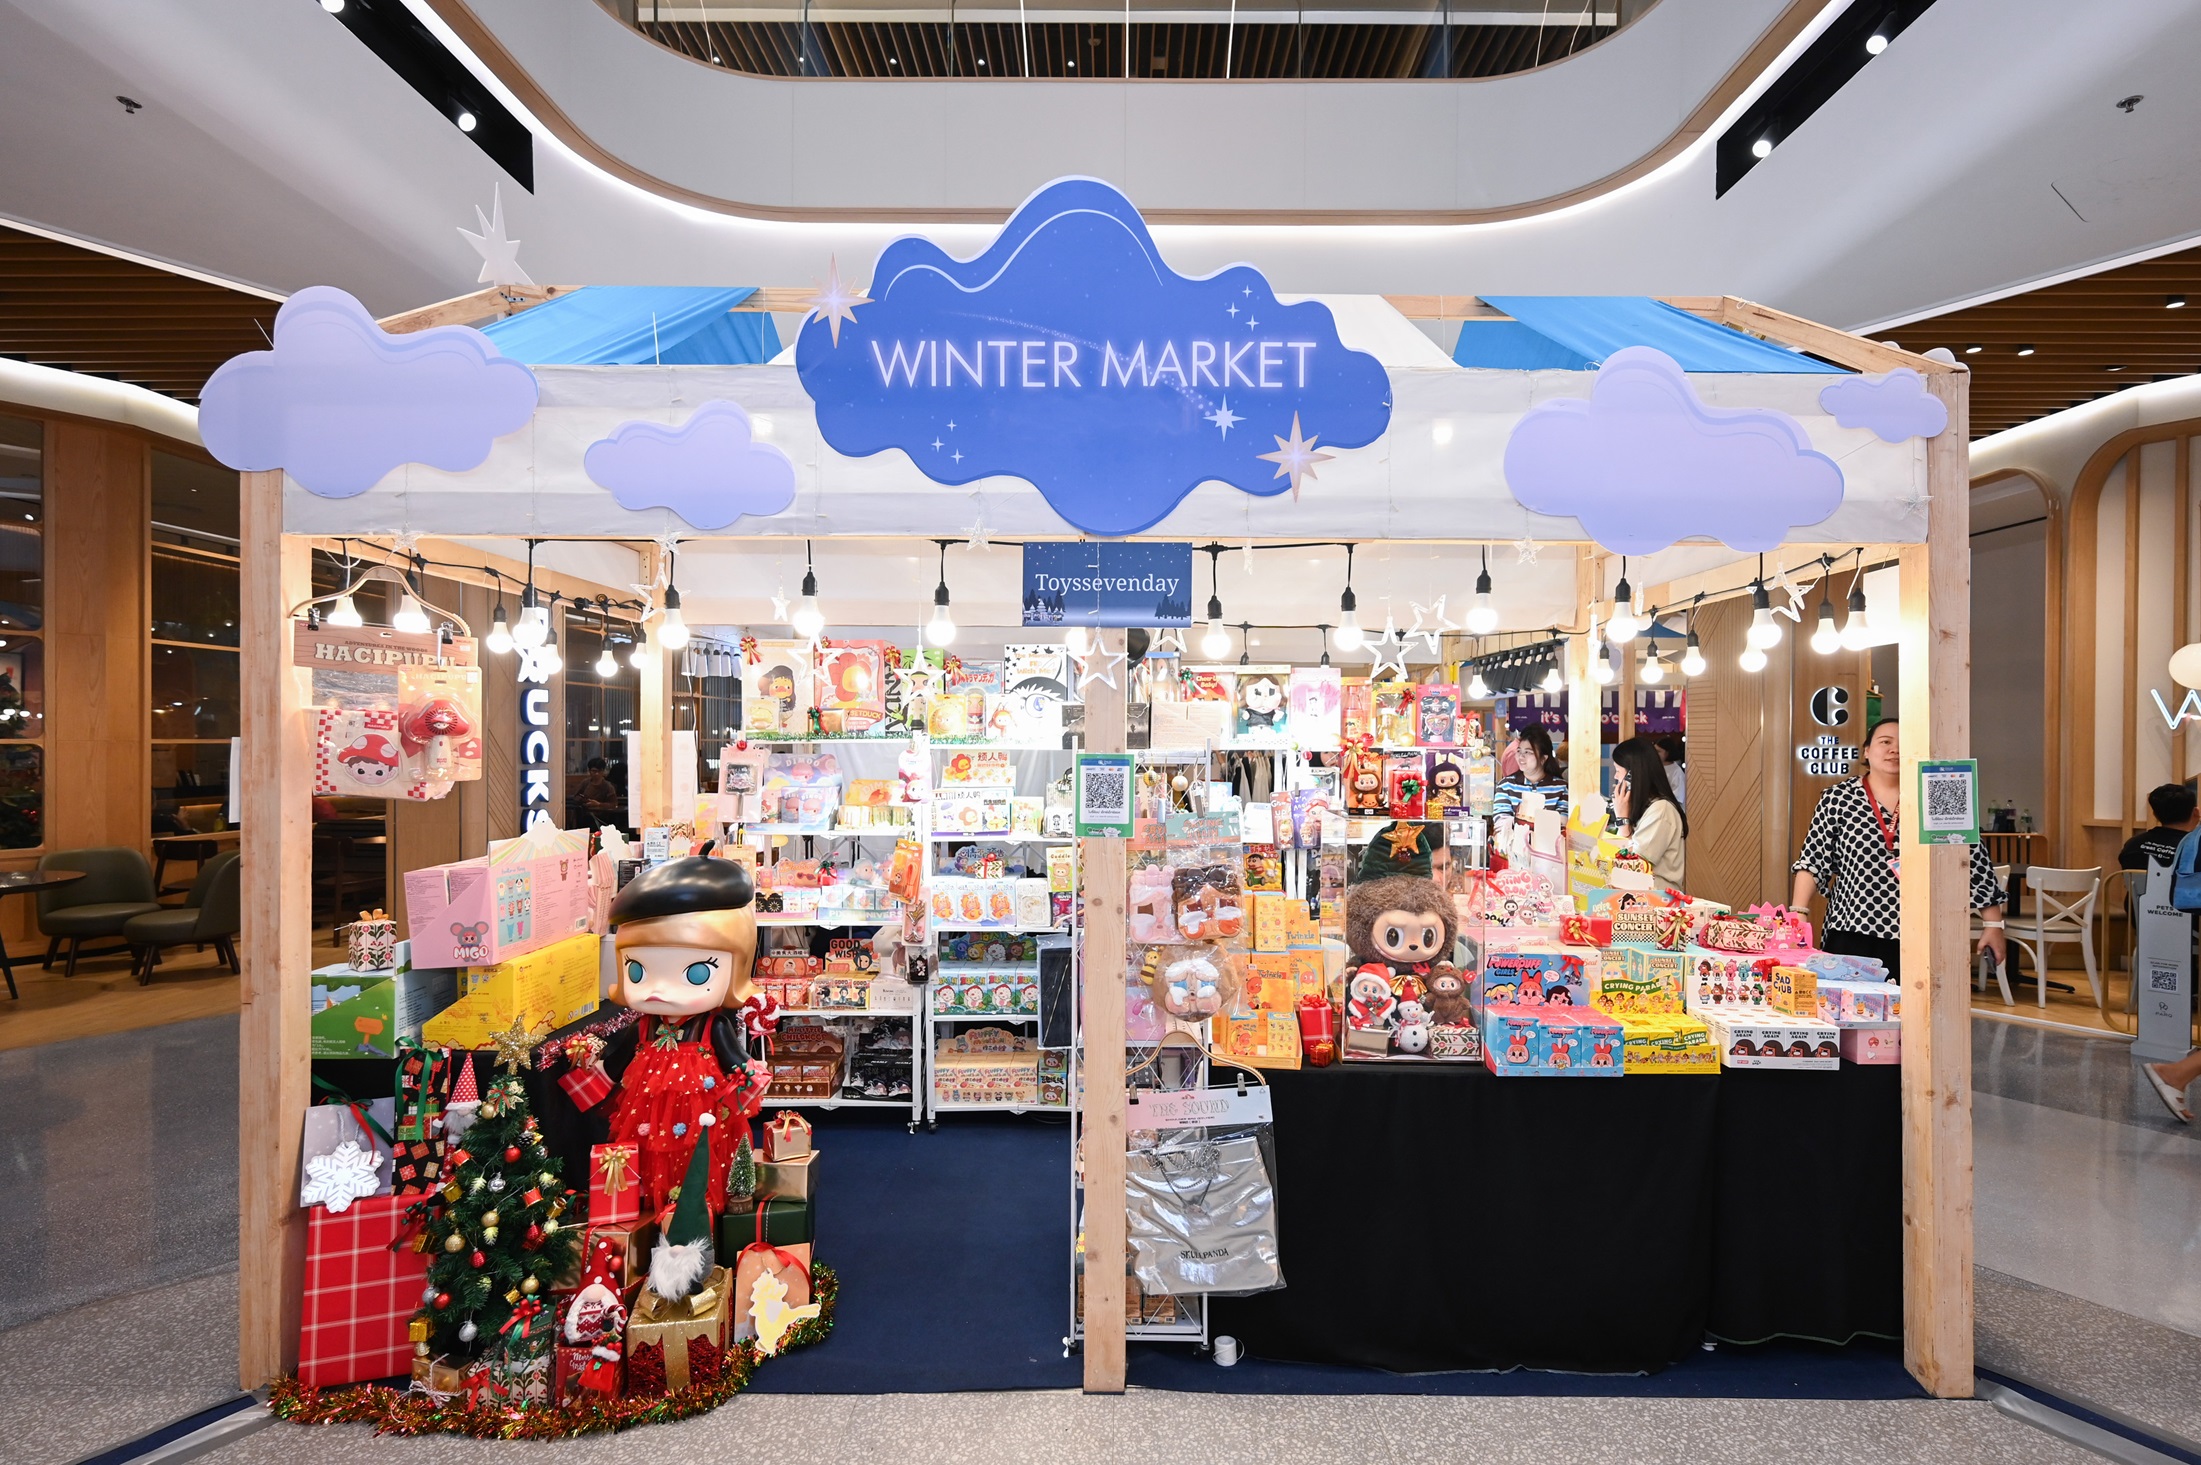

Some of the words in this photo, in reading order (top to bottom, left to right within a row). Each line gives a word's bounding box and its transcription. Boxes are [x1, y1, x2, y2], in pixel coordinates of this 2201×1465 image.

[872, 340, 1081, 388] WINTER
[1102, 340, 1317, 388] MARKET
[1035, 572, 1180, 598] Toyssevenday
[344, 640, 383, 648] ADVENTURES
[1821, 736, 1840, 745] THE
[1801, 747, 1859, 760] COFFEE
[786, 757, 820, 768] DIMOO
[1810, 763, 1850, 775] CLUB
[863, 782, 892, 793] DIMO
[1616, 912, 1655, 922] SUNSET
[2147, 909, 2184, 918] WELCOME
[830, 940, 861, 949] GOOD
[453, 946, 489, 960] MIGO
[1487, 957, 1542, 970] POWERPUFF
[1775, 972, 1791, 985] SAD
[1604, 983, 1634, 991] CRYING
[1635, 981, 1661, 992] PARAD
[1773, 982, 1792, 994] CLUB
[1684, 1032, 1706, 1041] CRYING
